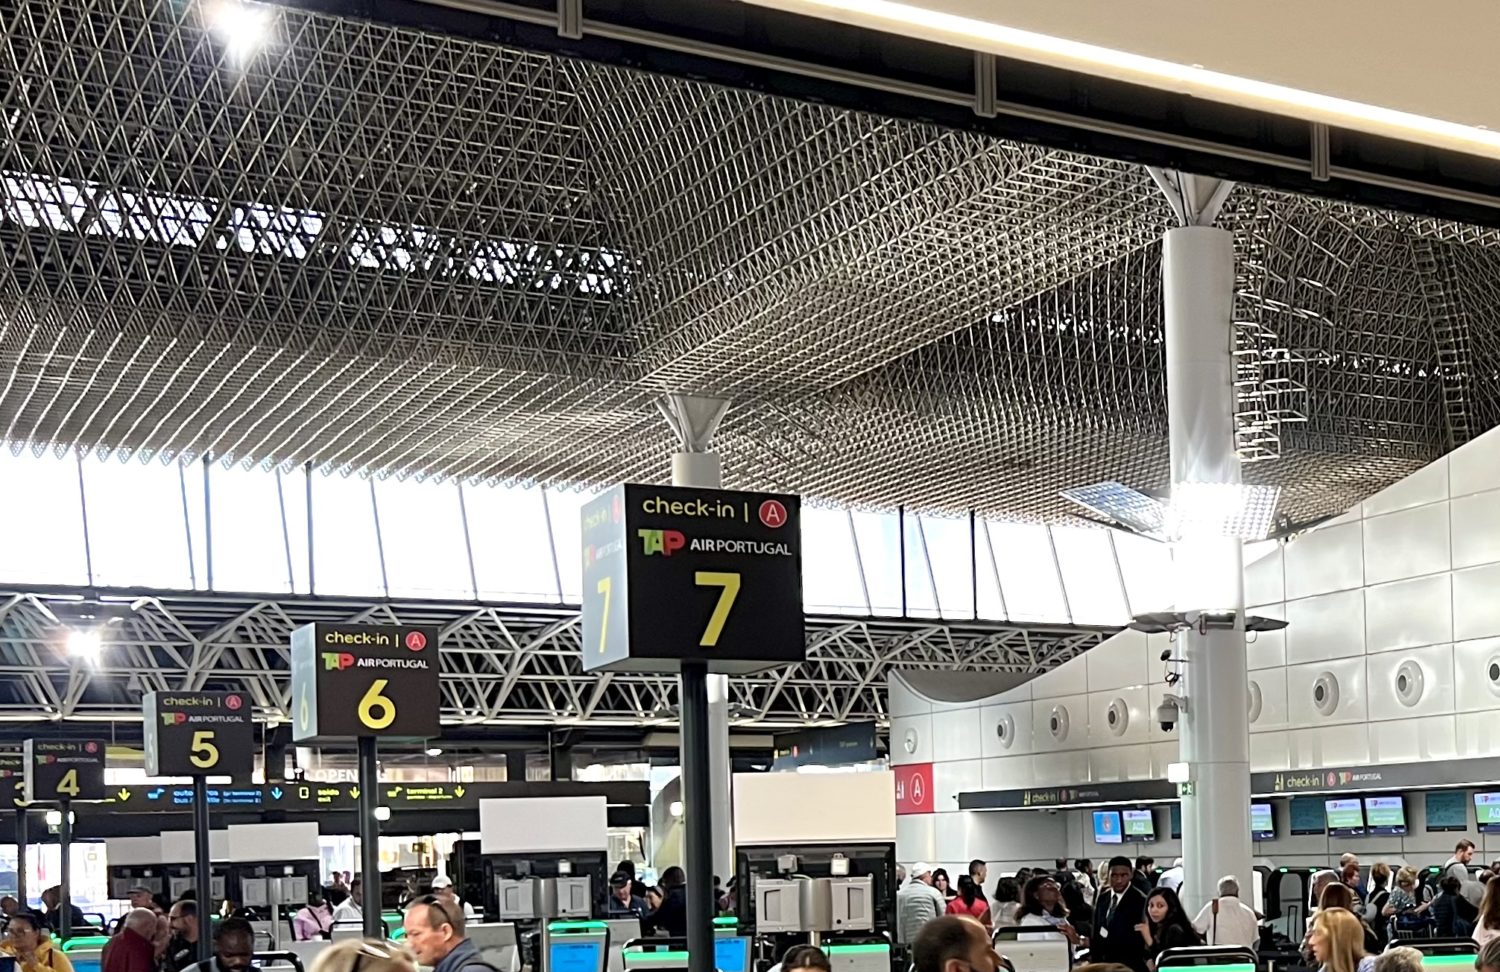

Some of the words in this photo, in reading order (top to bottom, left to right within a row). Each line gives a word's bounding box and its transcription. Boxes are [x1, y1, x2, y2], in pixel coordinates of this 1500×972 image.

[643, 496, 735, 519] check-in
[638, 529, 685, 556] TAP
[597, 576, 611, 653] 7
[695, 571, 741, 647] 7
[325, 631, 389, 645] check-in
[321, 652, 355, 671] TAP
[163, 696, 213, 706] check-in
[358, 679, 396, 729] 6
[190, 731, 219, 768] 5
[56, 769, 80, 796] 4
[1287, 774, 1319, 788] check-in
